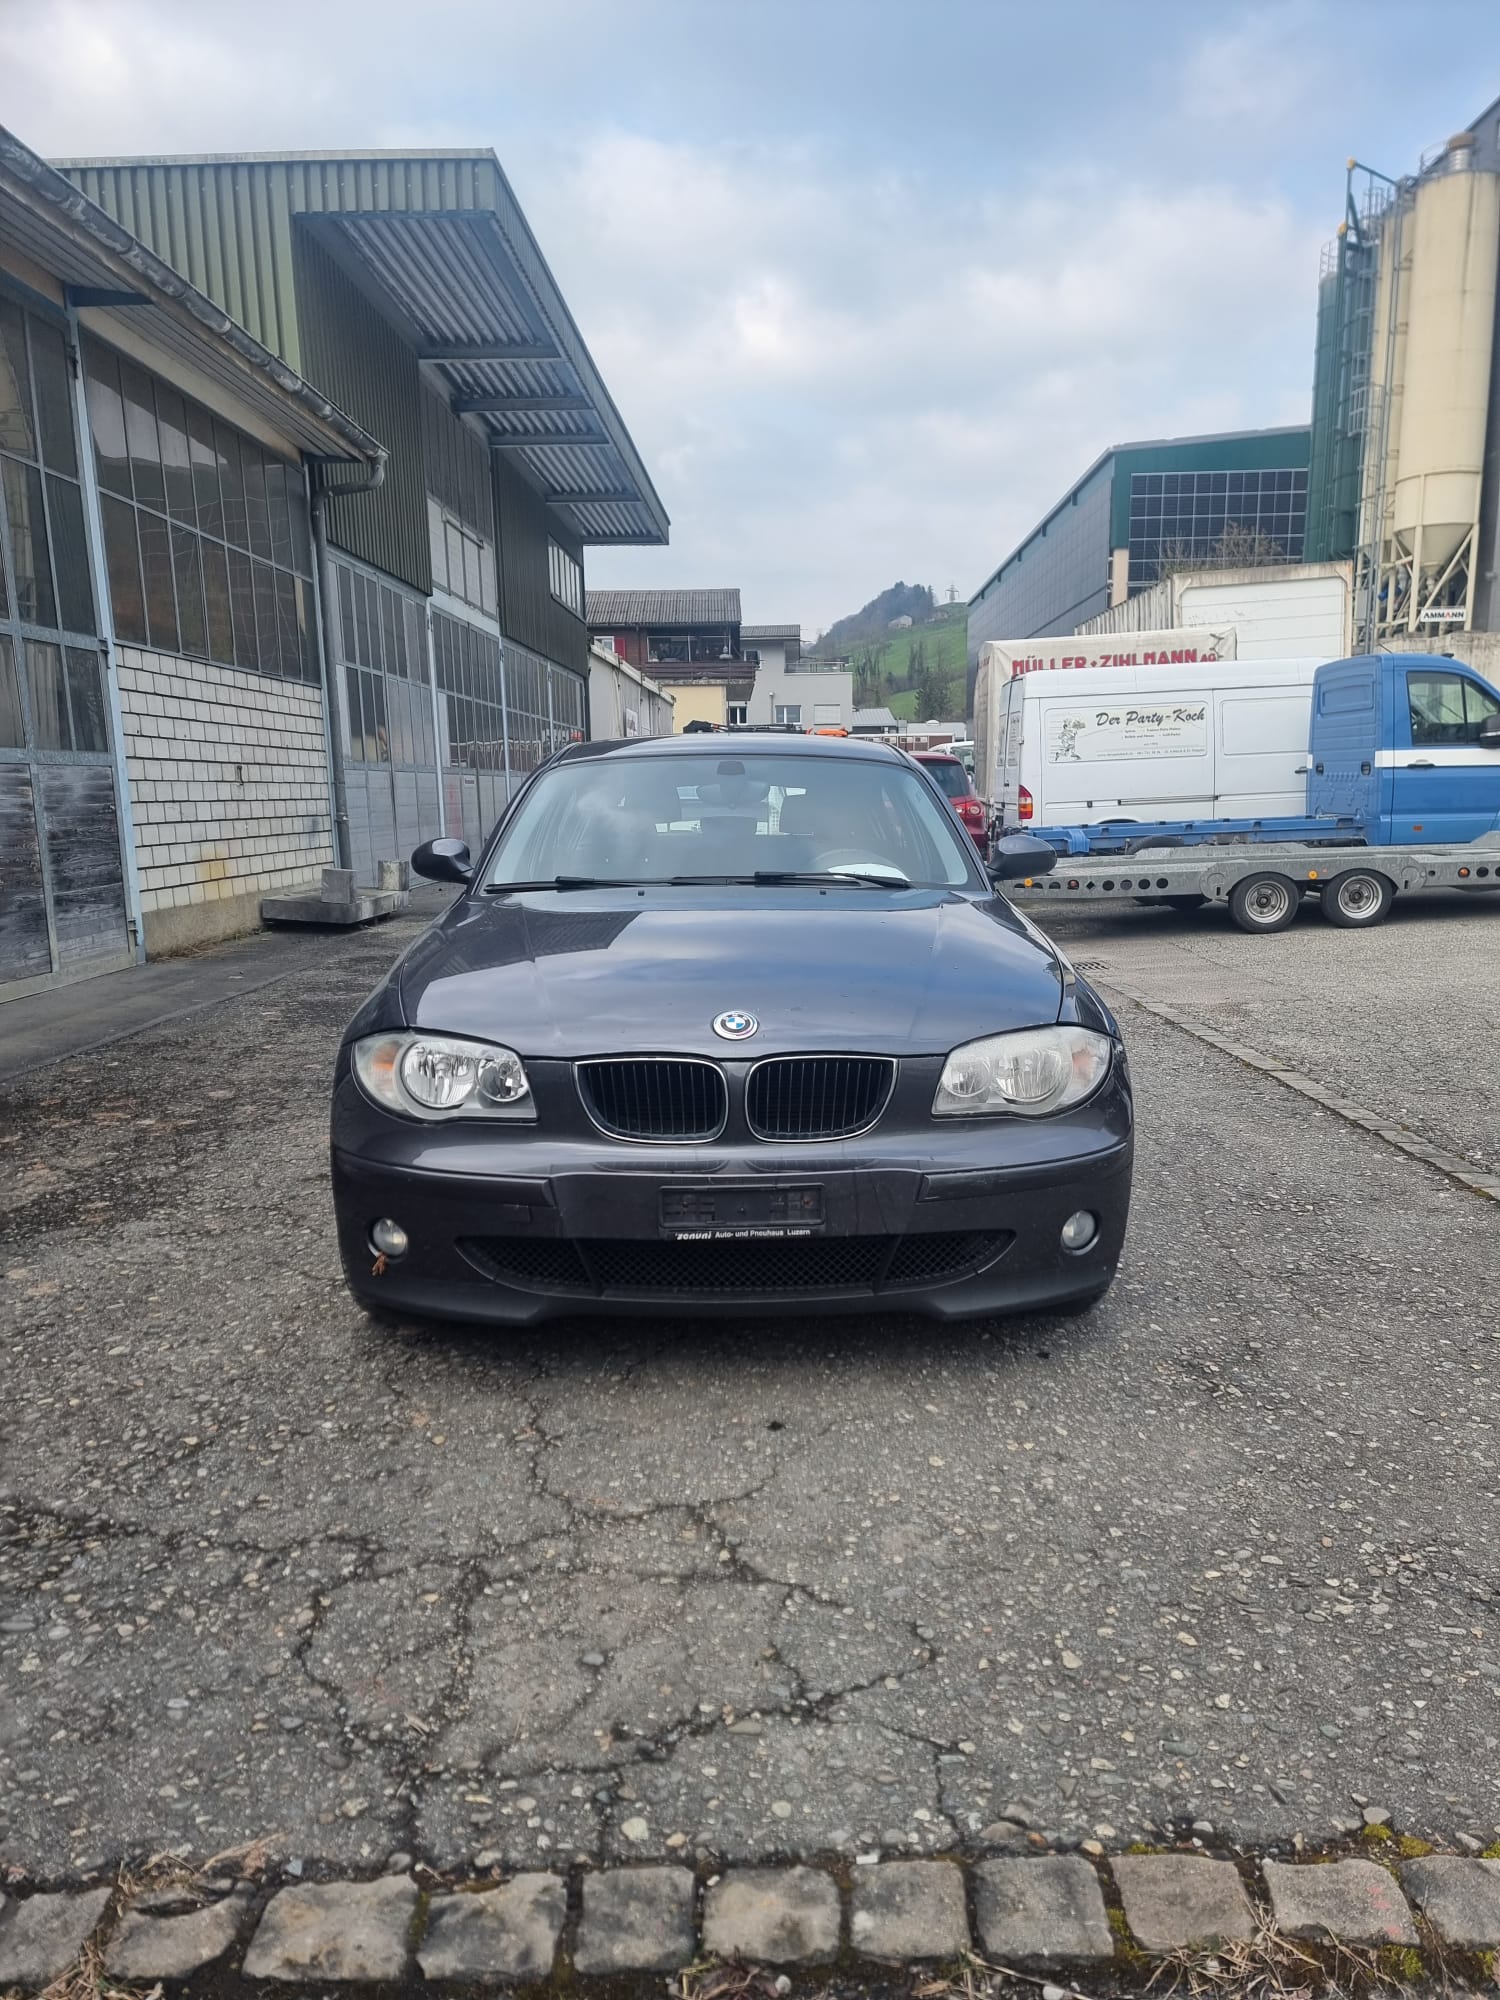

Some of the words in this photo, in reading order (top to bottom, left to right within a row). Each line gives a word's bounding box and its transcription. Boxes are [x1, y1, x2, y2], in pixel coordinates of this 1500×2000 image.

[1423, 611, 1465, 619] AMMANN
[1099, 648, 1198, 668] ZIHLMANN
[1096, 712, 1121, 726] Der
[1126, 707, 1206, 727] Party-Koch
[715, 1231, 734, 1239] Auto-
[735, 1229, 749, 1238] und
[787, 1228, 811, 1236] Luzern
